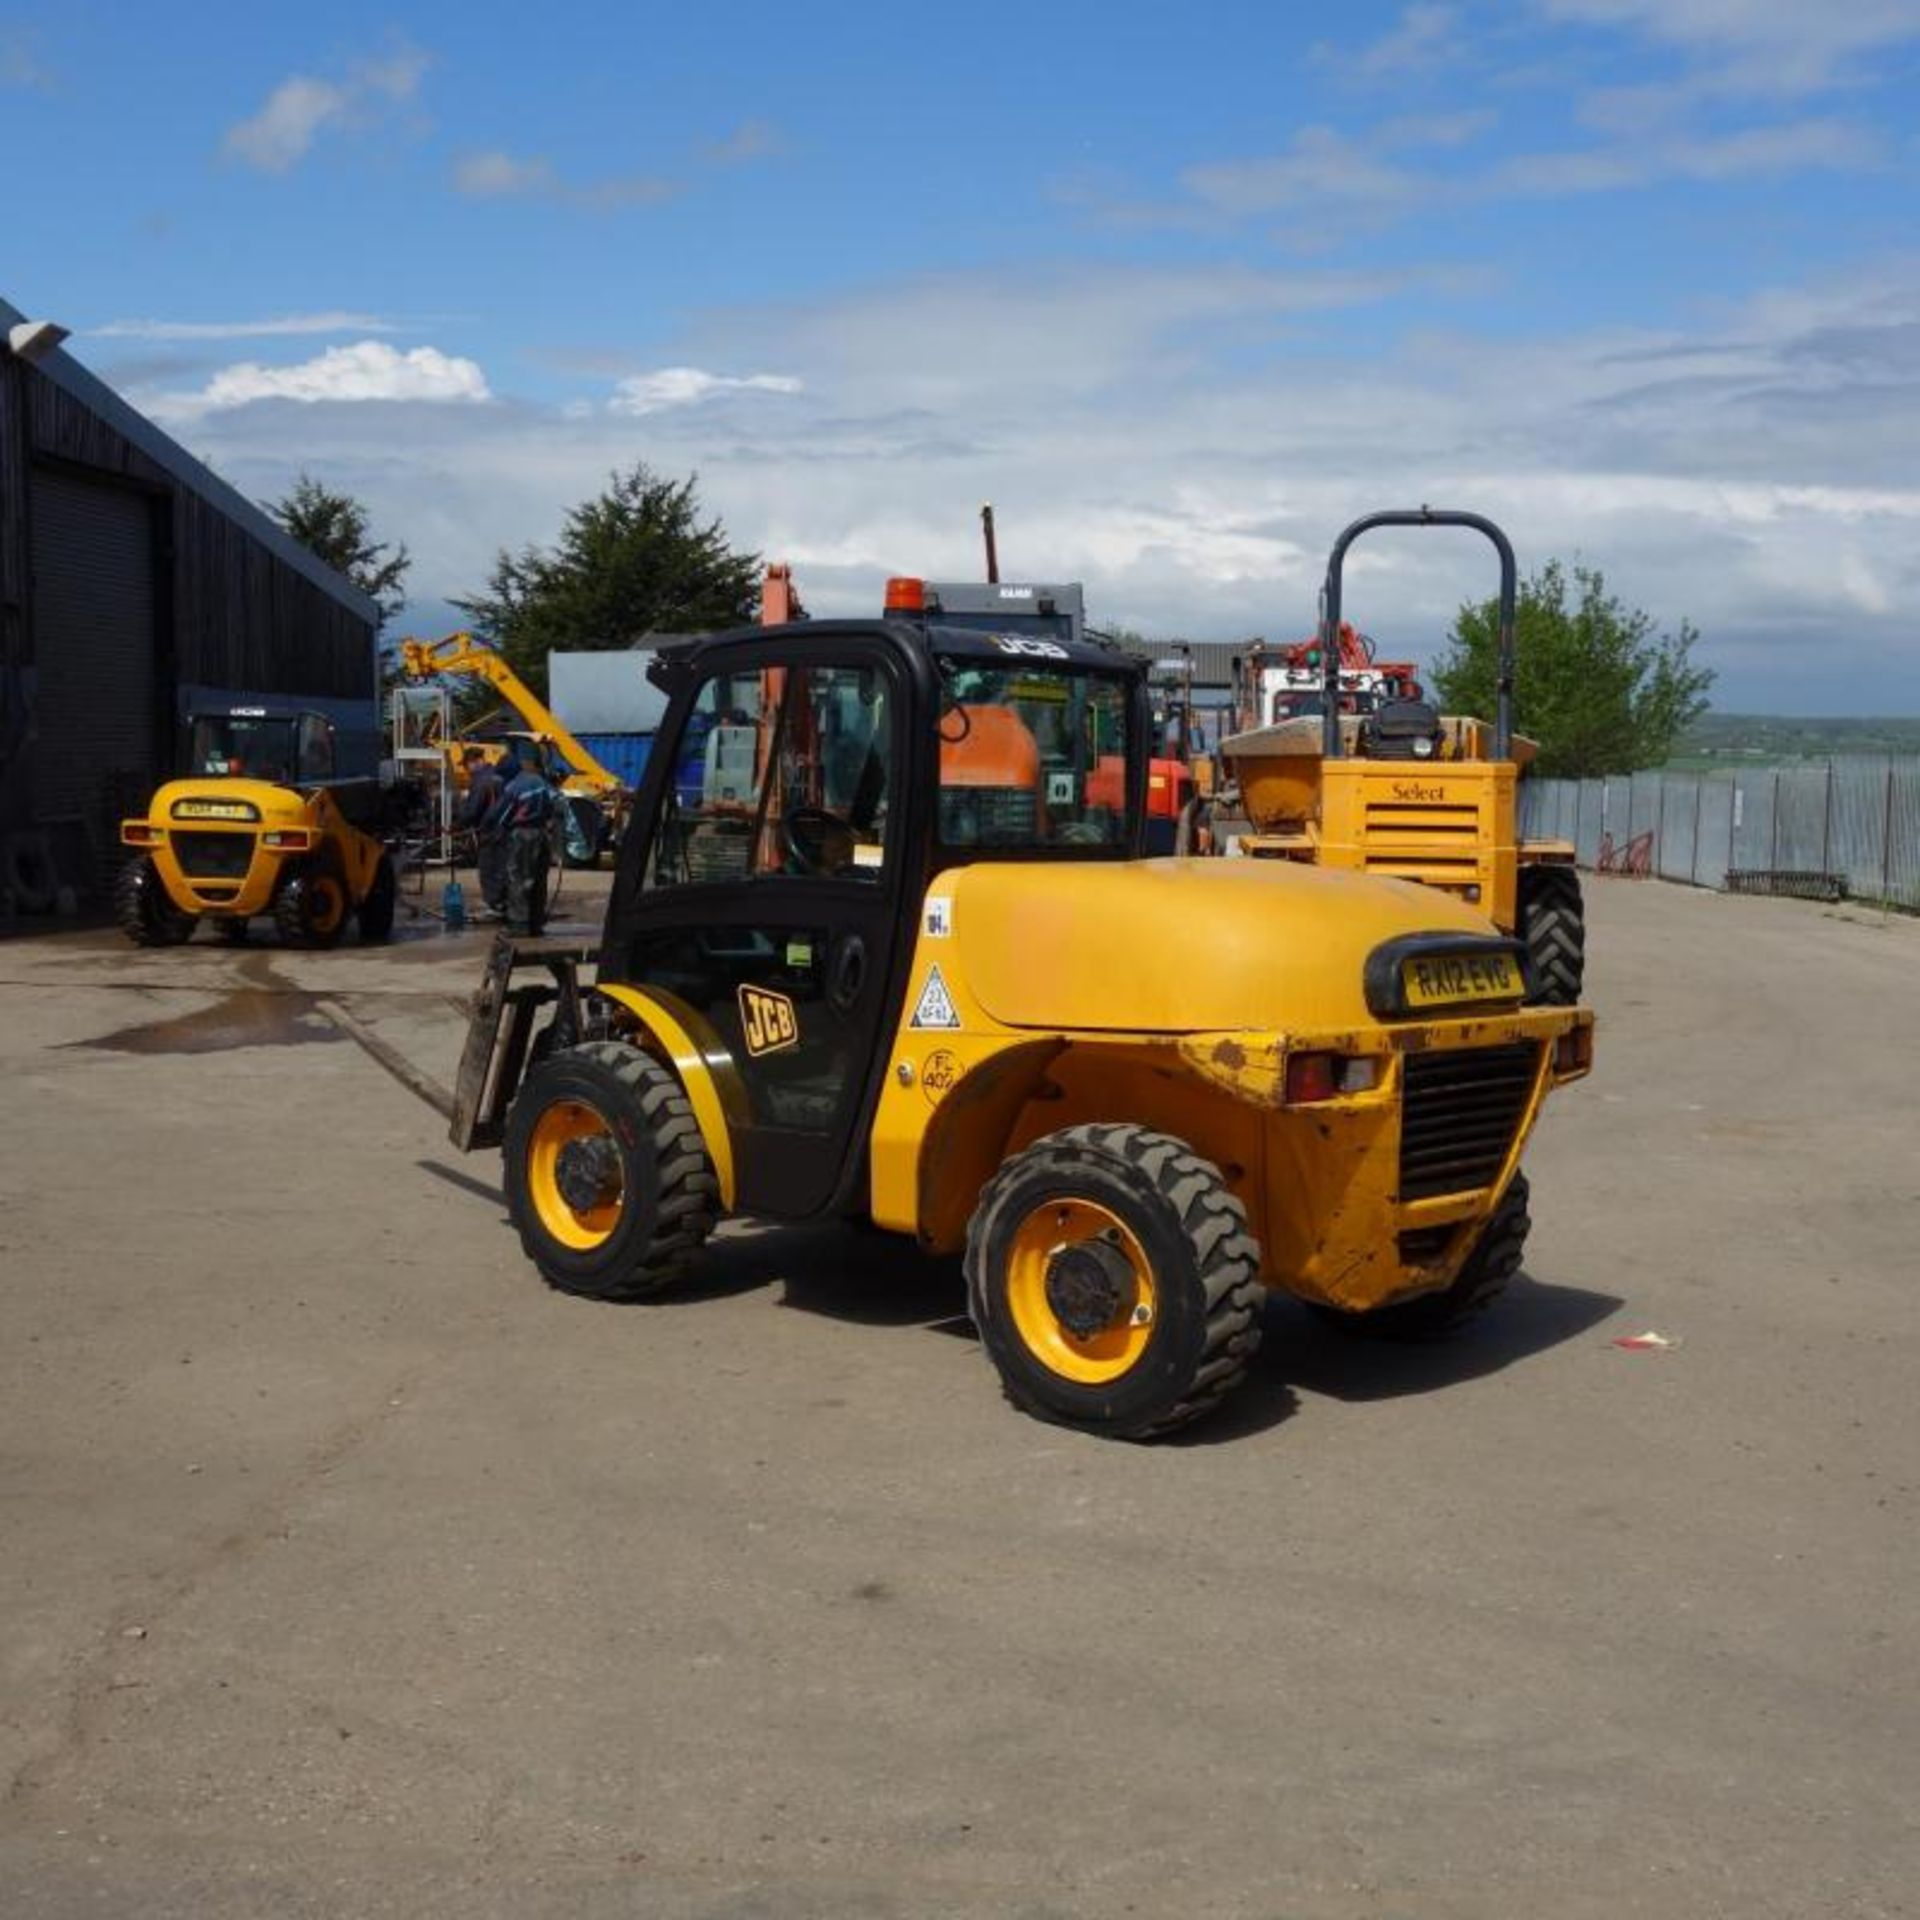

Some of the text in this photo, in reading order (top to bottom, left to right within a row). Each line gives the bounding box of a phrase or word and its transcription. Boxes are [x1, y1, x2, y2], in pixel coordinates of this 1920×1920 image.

[1000, 638, 1068, 659] JCB
[1392, 782, 1443, 800] Select
[745, 992, 793, 1048] JCB
